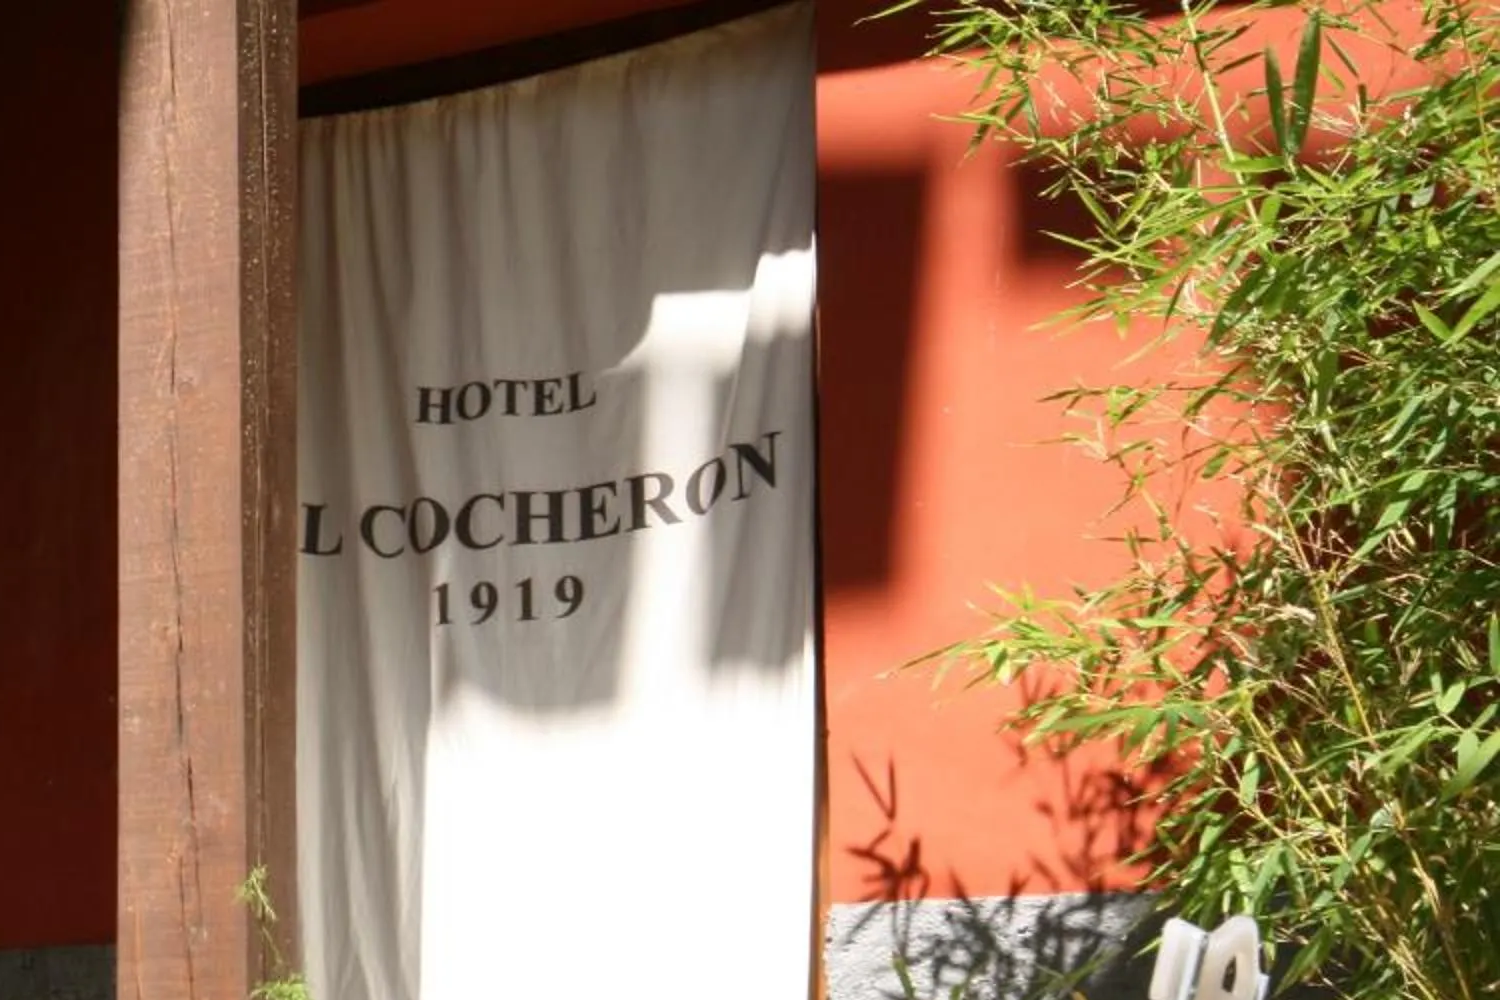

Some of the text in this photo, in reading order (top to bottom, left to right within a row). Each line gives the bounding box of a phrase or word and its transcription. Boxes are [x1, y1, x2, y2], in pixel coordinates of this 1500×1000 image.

[414, 371, 598, 425] HOTEL
[299, 431, 784, 559] L COCHERON
[433, 574, 585, 626] 1919
